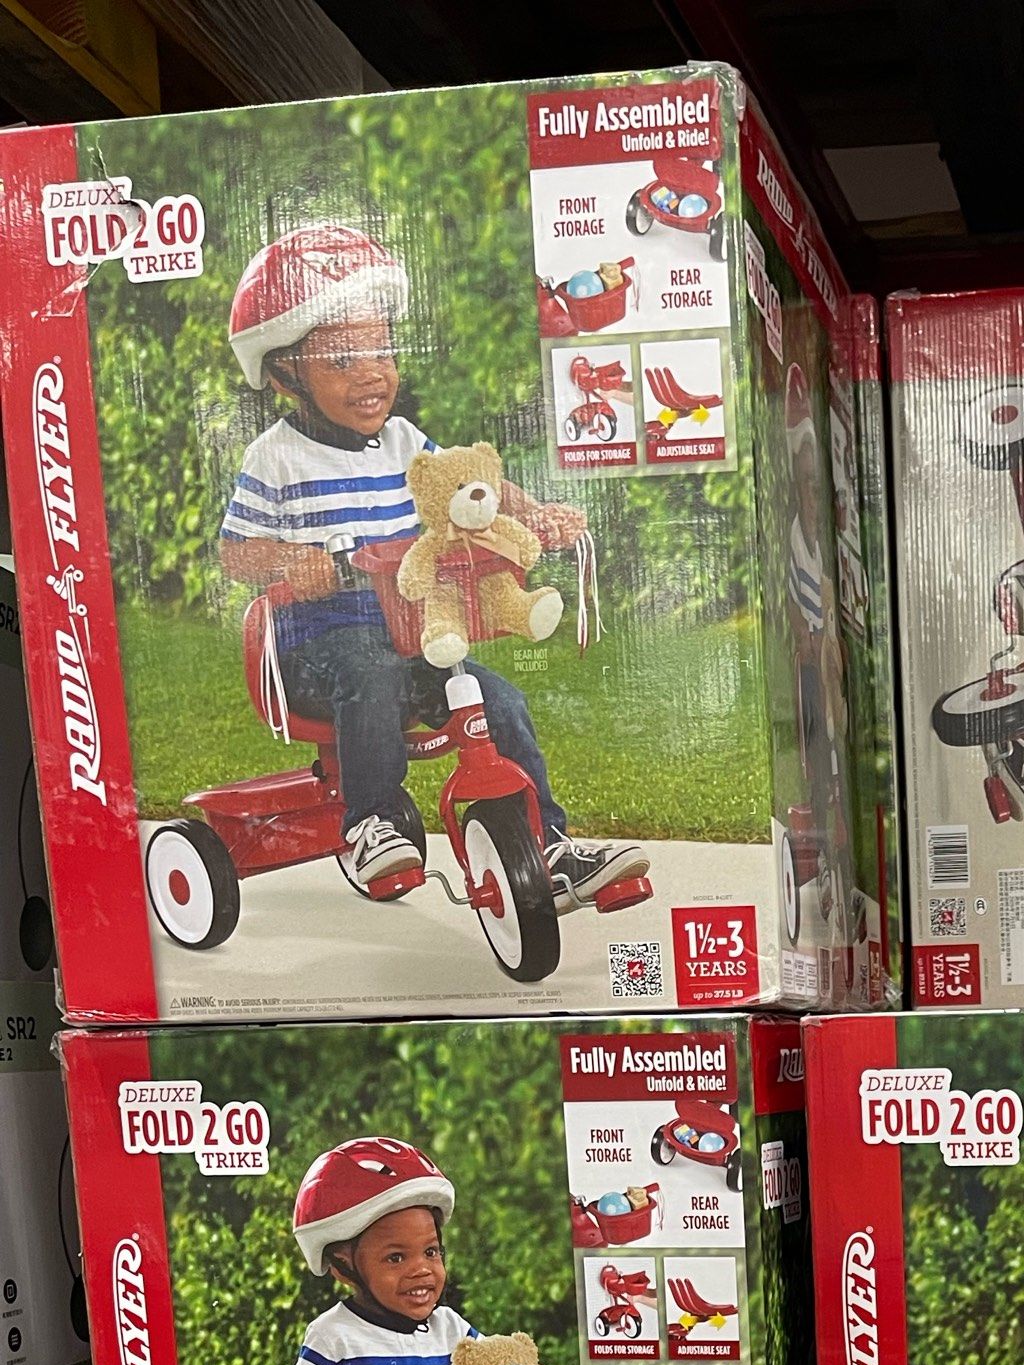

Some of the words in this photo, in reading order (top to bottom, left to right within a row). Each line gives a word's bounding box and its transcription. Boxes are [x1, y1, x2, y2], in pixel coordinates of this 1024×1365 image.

[537, 105, 589, 139] Fully
[594, 93, 711, 133] Assembled
[621, 133, 664, 153] Unfold
[665, 131, 676, 149] &
[677, 128, 710, 148] Ride!
[48, 184, 130, 209] DELUXE
[559, 197, 597, 215] FRONT
[51, 213, 127, 259] FOLD
[133, 211, 148, 249] 2
[156, 202, 198, 246] GO
[553, 219, 606, 238] STORAGE
[130, 252, 196, 275] TRIKE
[670, 268, 701, 286] REAR
[661, 289, 713, 309] STORAGE
[564, 450, 585, 462] FOLDS
[586, 450, 600, 461] FOR
[601, 446, 632, 460] STORAGE
[656, 444, 698, 458] ADJUSTABLE
[699, 443, 715, 456] SEAT
[513, 649, 531, 661] BEAR
[532, 648, 548, 660] NOT
[514, 660, 548, 673] INCLUDED
[55, 618, 107, 807] RADIO
[685, 961, 748, 978] YEARS
[932, 953, 945, 998] YEARS
[693, 993, 703, 1001] up
[704, 991, 713, 999] to
[731, 989, 743, 998] LB
[6, 1016, 37, 1040] SR2
[570, 1046, 616, 1077] Fully
[621, 1044, 727, 1073] Assembled
[647, 1075, 684, 1092] Unfold
[687, 1076, 696, 1091] &
[697, 1074, 727, 1091] Ride!
[867, 1074, 945, 1092] DELUXE
[124, 1087, 196, 1103] DELUXE
[868, 1098, 940, 1138] FOLD
[950, 1097, 966, 1136] 2
[976, 1096, 1017, 1136] GO
[127, 1110, 194, 1147] FOLD
[202, 1109, 219, 1146] 2
[225, 1107, 264, 1146] GO
[590, 1129, 624, 1143] FRONT
[585, 1147, 632, 1163] STORAGE
[947, 1141, 1014, 1160] TRIKE
[202, 1151, 263, 1169] TRIKE
[765, 1167, 783, 1204] FOLD
[691, 1196, 719, 1210] REAR
[683, 1215, 730, 1230] STORAGE
[594, 1345, 612, 1355] FOLDS
[613, 1345, 625, 1355] FOR
[626, 1345, 655, 1356] STORAGE
[677, 1345, 714, 1356] ADJUSTABLE
[715, 1345, 730, 1356] SEAT
